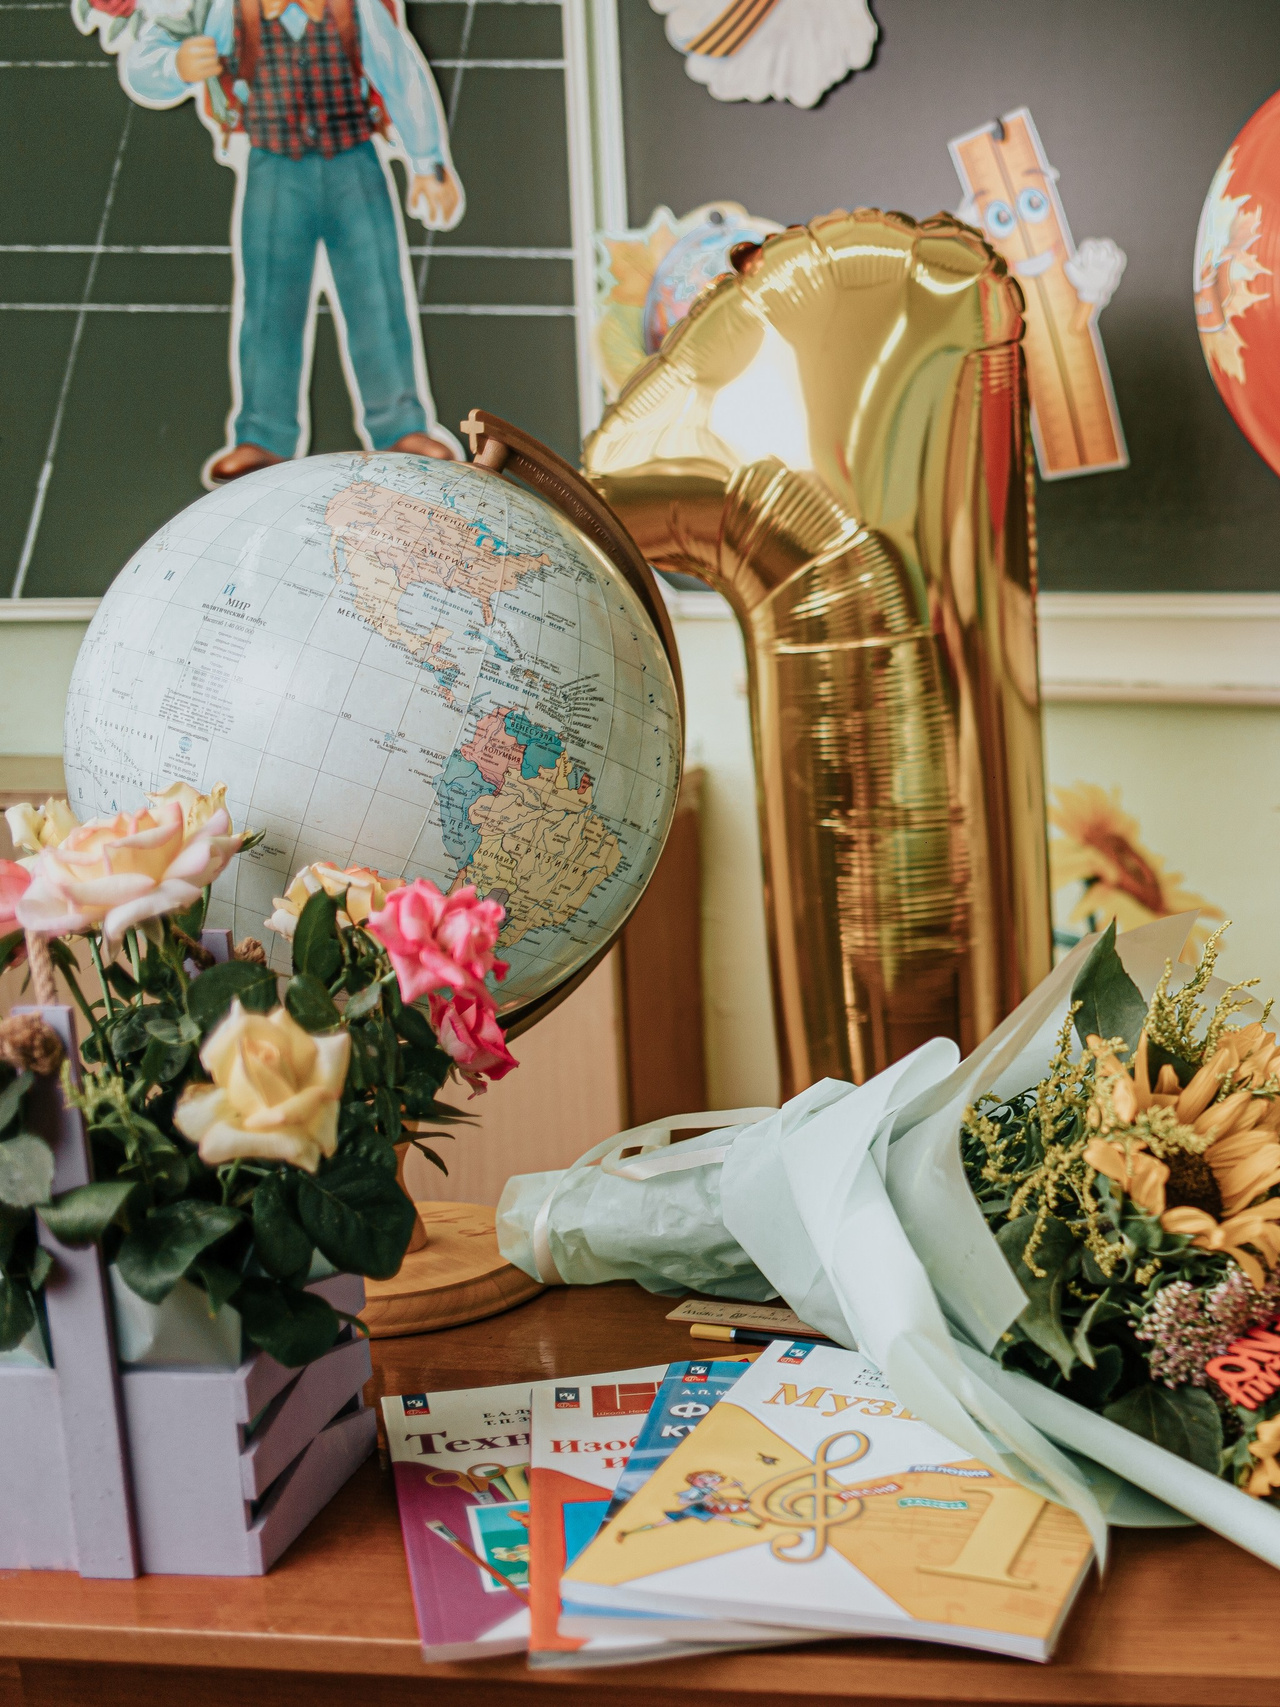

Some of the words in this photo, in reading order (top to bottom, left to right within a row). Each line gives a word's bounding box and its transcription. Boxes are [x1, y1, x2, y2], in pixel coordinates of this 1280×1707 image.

[370, 528, 412, 548] ШТАТЫ
[420, 546, 475, 571] АМЕРИКИ
[225, 598, 251, 611] МИР
[430, 605, 450, 616] залив
[202, 603, 245, 620] политический
[246, 615, 267, 627] глобус
[336, 607, 384, 630] МЕКСИКА
[510, 721, 554, 743] ВЕНЕСУЭЛА
[418, 747, 447, 761] ЭКВАДОР
[483, 745, 521, 764] КОЛУМБИЯ
[449, 819, 479, 834] ПЕРУ
[477, 848, 515, 865] БОЛИВИЯ
[514, 843, 589, 878] БРАЗИЛИЯ
[499, 1418, 515, 1426] П.
[914, 1464, 991, 1478] МЕЛОДИЯ
[915, 1486, 1039, 1591] 1
